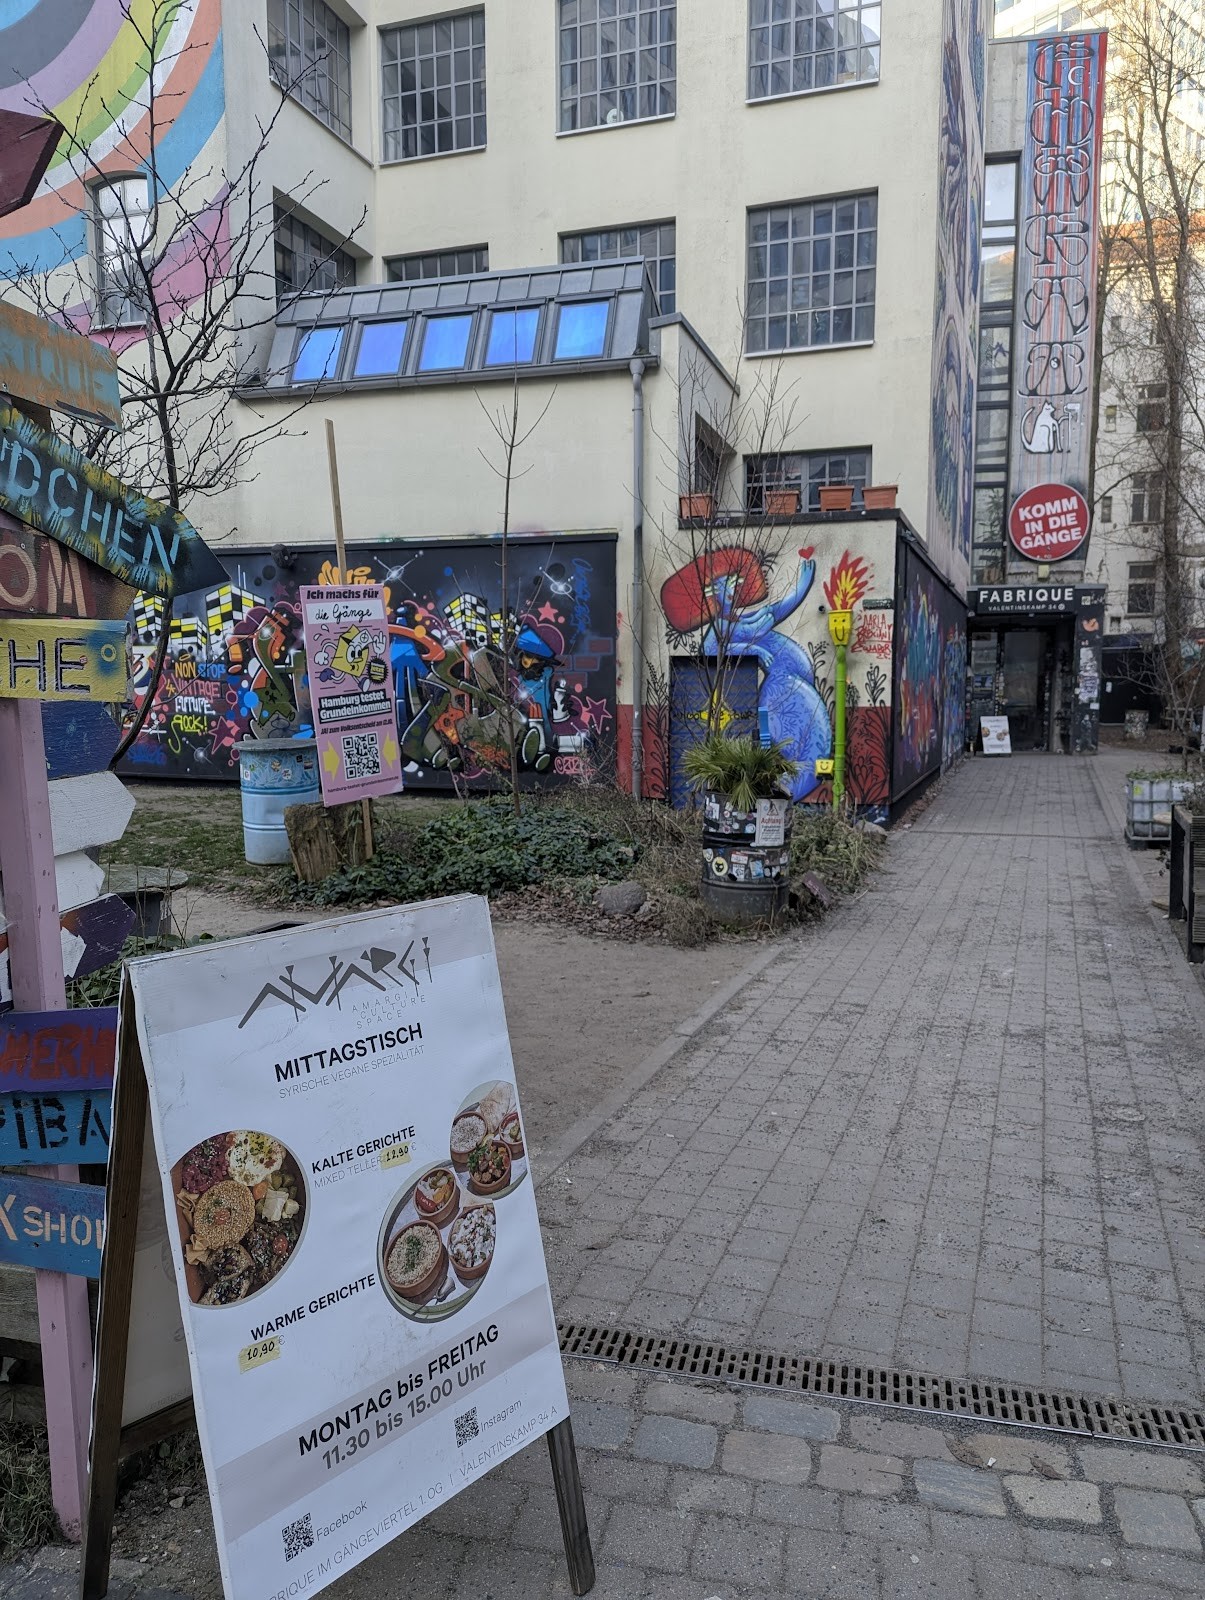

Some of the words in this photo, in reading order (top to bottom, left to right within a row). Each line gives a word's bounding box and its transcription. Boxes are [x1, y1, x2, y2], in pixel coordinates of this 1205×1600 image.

[0, 438, 180, 575] DCHEN
[1018, 496, 1079, 521] KOMM
[1025, 520, 1043, 534] IN
[1049, 512, 1078, 530] DIE
[1020, 527, 1083, 549] GÄNGE
[307, 590, 324, 599] Ich
[326, 590, 361, 599] machs
[363, 588, 379, 598] für
[979, 588, 1074, 603] FABRIQUE
[315, 608, 329, 620] die
[332, 604, 372, 624] Gänge
[0, 637, 90, 693] HE
[175, 662, 196, 678] NON
[198, 663, 226, 678] STOP
[320, 701, 391, 719] Grundeinkommen
[321, 694, 360, 708] Hamburg
[360, 691, 384, 701] testet
[352, 992, 409, 1013] AMARGI
[360, 995, 426, 1019] CULTURE
[357, 1011, 402, 1029] SPACE
[275, 1023, 423, 1082] MITTAGSTISCH
[279, 1076, 330, 1099] SYRISCHE
[331, 1063, 370, 1082] VEGANE
[372, 1044, 425, 1070] SPEZIALITÄT
[312, 1149, 354, 1174] KALTE
[356, 1126, 416, 1157] GERICHTE
[314, 1170, 346, 1189] MIXED
[347, 1155, 382, 1177] TELLER
[251, 1306, 306, 1341] WARME
[308, 1274, 376, 1313] GERICHTE
[247, 1341, 275, 1360] 10,90
[298, 1389, 392, 1456] MONTAG
[398, 1373, 424, 1399] bis
[428, 1324, 499, 1380] FREITAG
[323, 1428, 370, 1470] 11.30
[376, 1411, 403, 1439] bis
[407, 1379, 453, 1418] 15.00
[457, 1360, 486, 1388] Uhr
[481, 1400, 522, 1432] Instagram
[318, 1560, 332, 1577] IM
[334, 1501, 418, 1565] GÄNGEVIERTEL
[427, 1482, 443, 1499] OG
[460, 1418, 536, 1476] VALENTINSKAMP
[538, 1412, 549, 1425] 34
[551, 1406, 558, 1414] A
[316, 1500, 368, 1541] Facebook
